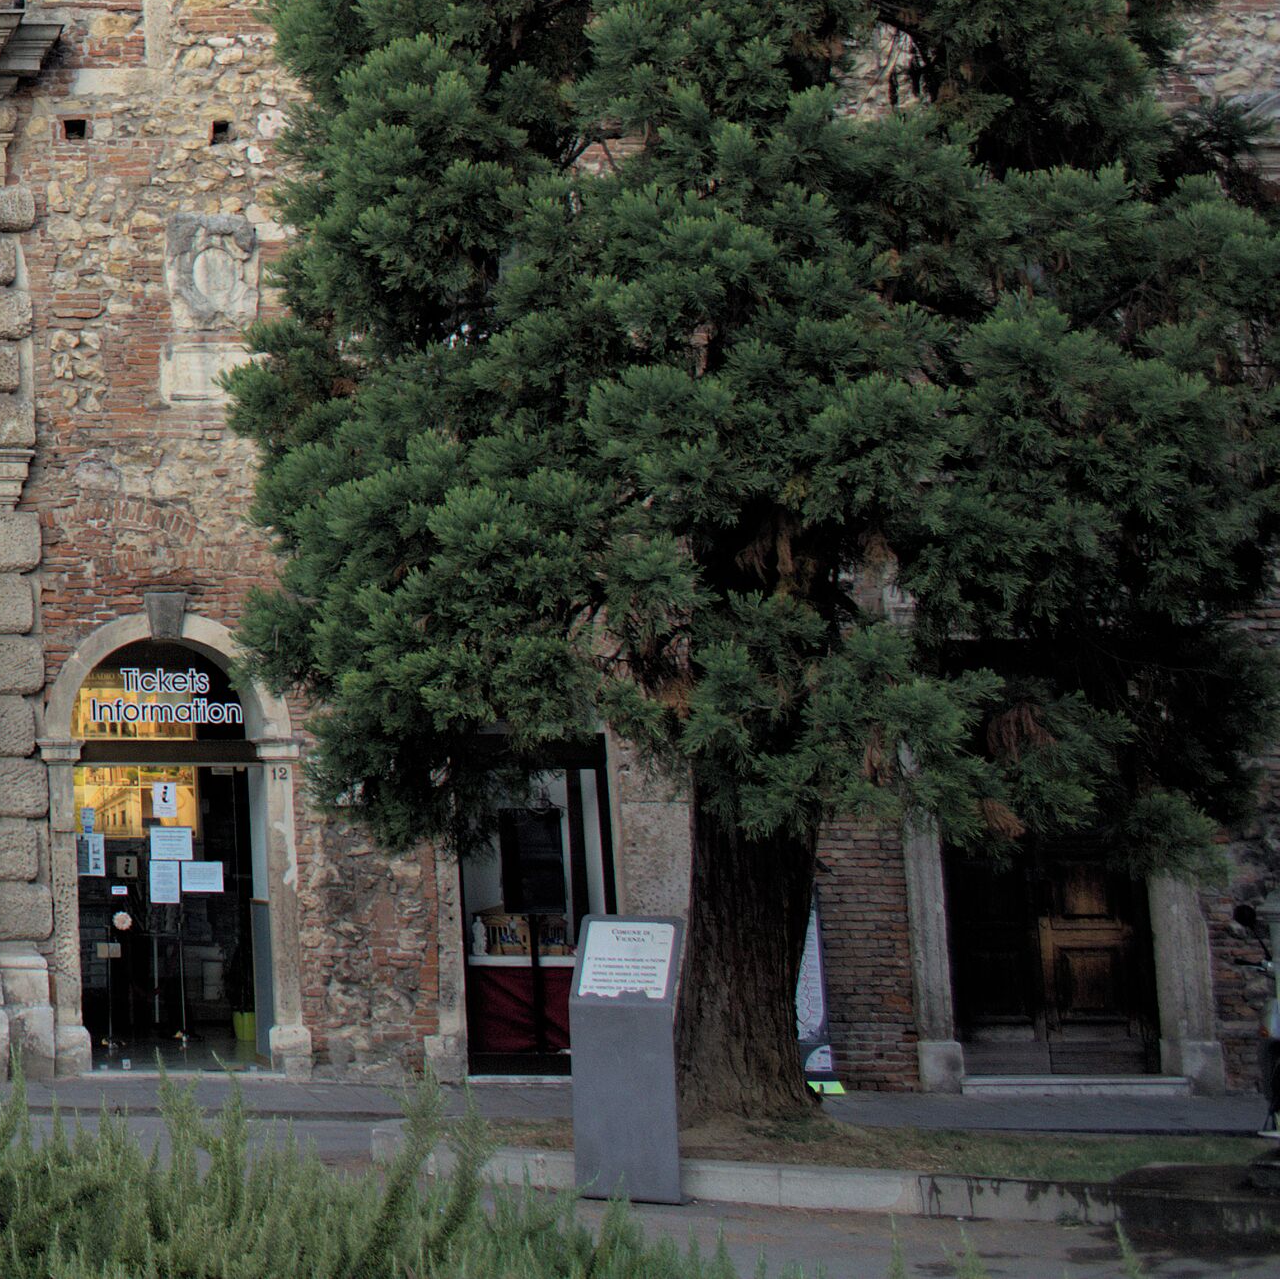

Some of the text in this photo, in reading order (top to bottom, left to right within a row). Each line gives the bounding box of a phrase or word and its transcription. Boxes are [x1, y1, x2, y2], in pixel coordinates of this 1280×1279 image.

[120, 668, 210, 693] Tickets
[90, 698, 243, 723] Information
[271, 767, 288, 781] 12
